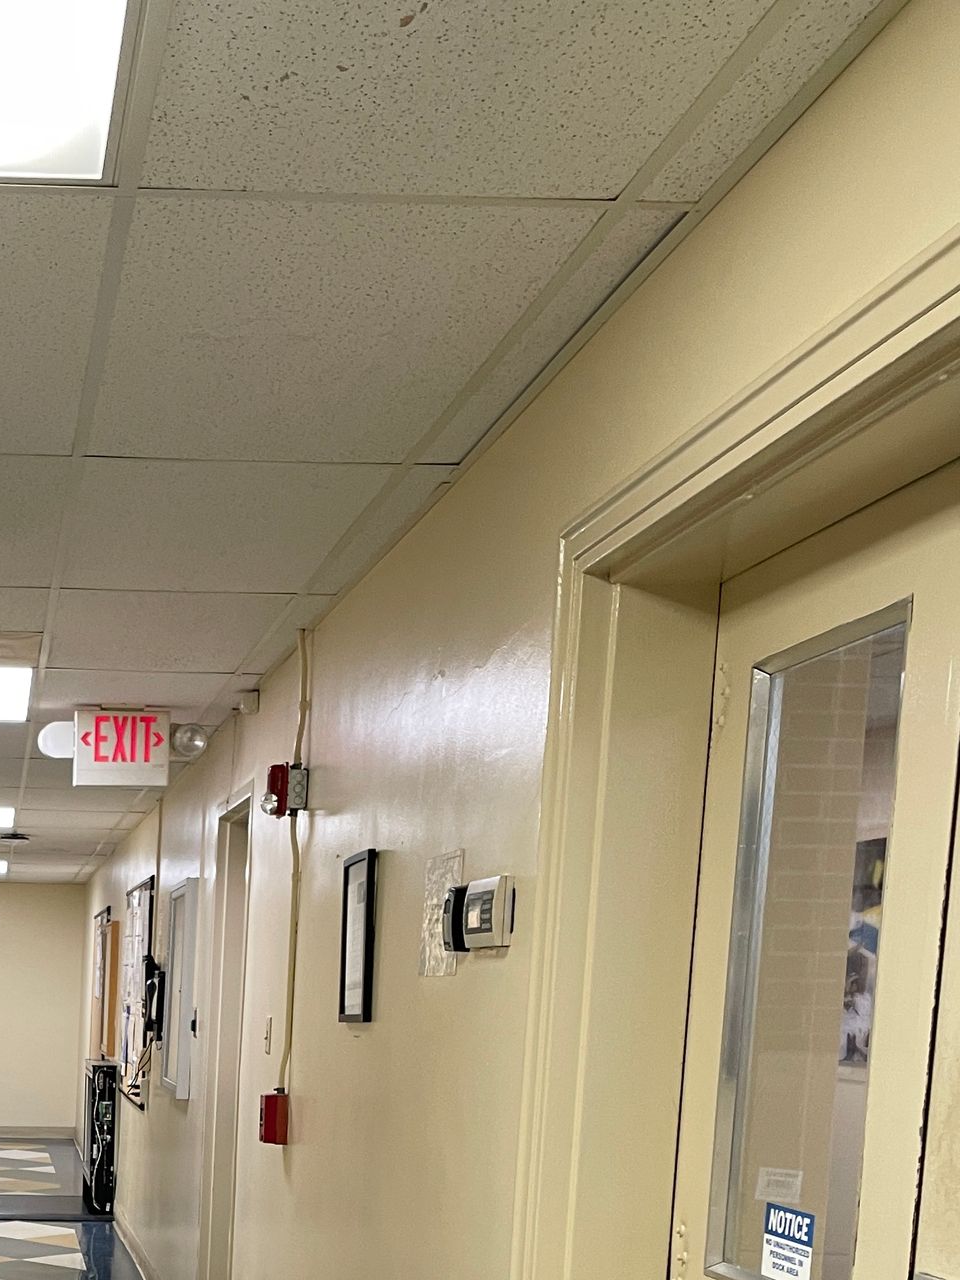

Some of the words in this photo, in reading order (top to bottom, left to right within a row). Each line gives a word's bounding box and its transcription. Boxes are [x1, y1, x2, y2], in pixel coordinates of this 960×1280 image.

[94, 716, 157, 763] EXIT
[768, 1208, 811, 1242] NOTICE
[765, 1238, 772, 1246] NO
[773, 1240, 810, 1258] UNAUTHORIZED
[769, 1249, 797, 1266] PERSONNEL
[798, 1259, 803, 1268] IN
[772, 1261, 785, 1272] DOCK
[786, 1266, 799, 1277] AREA
